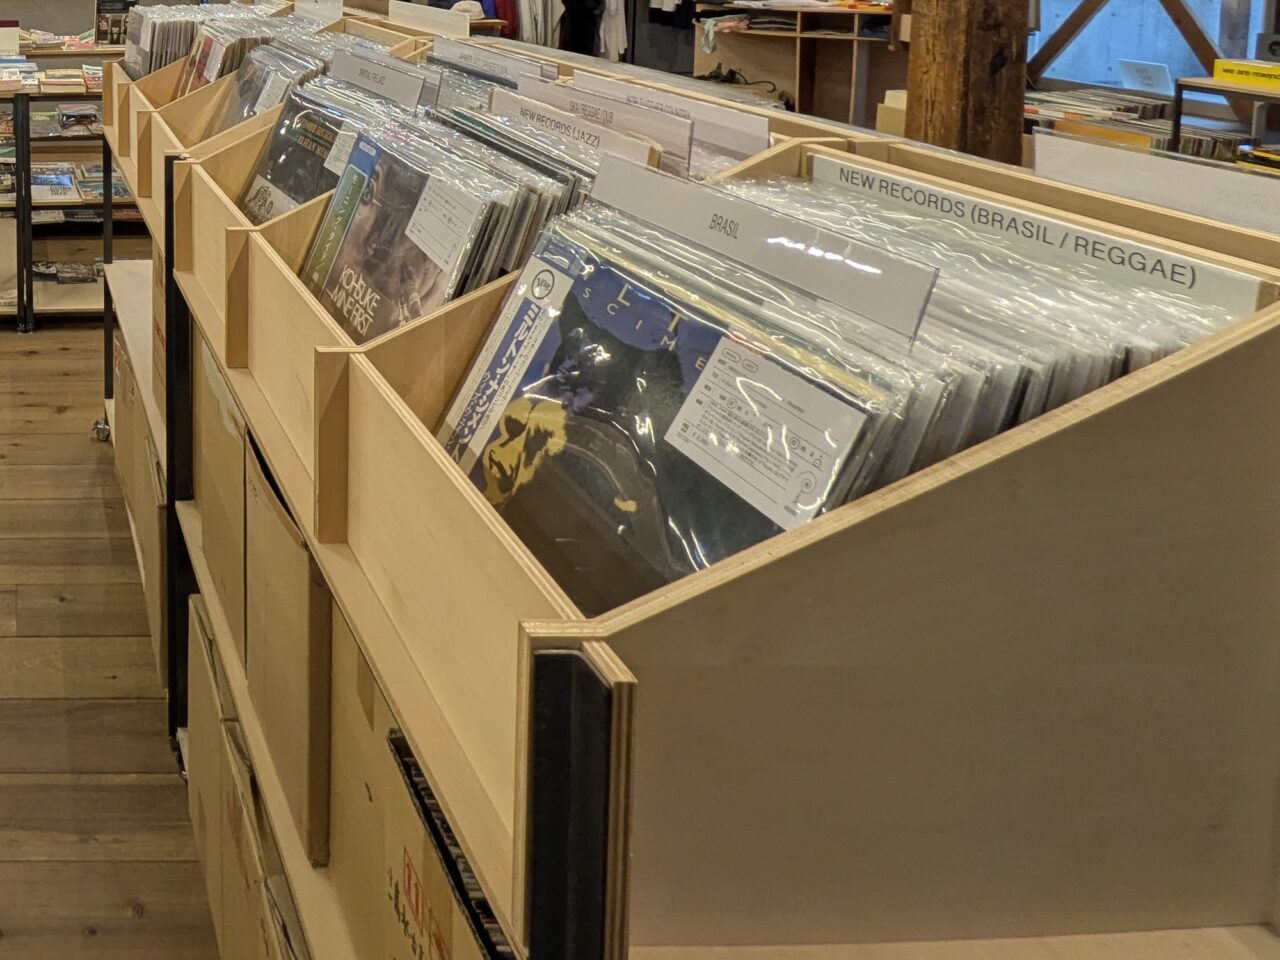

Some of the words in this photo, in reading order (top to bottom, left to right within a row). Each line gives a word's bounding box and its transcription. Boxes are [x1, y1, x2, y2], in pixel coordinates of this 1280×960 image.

[520, 107, 535, 122] NEW
[536, 112, 571, 138] RECORDS
[572, 125, 601, 149] (JAZZ)
[709, 213, 740, 240] BRASIL
[839, 167, 876, 191] NEW
[878, 178, 965, 218] RECORDS
[971, 204, 1054, 246] (BRASIL
[1058, 232, 1068, 249] /
[1074, 235, 1197, 290] REGGAE)
